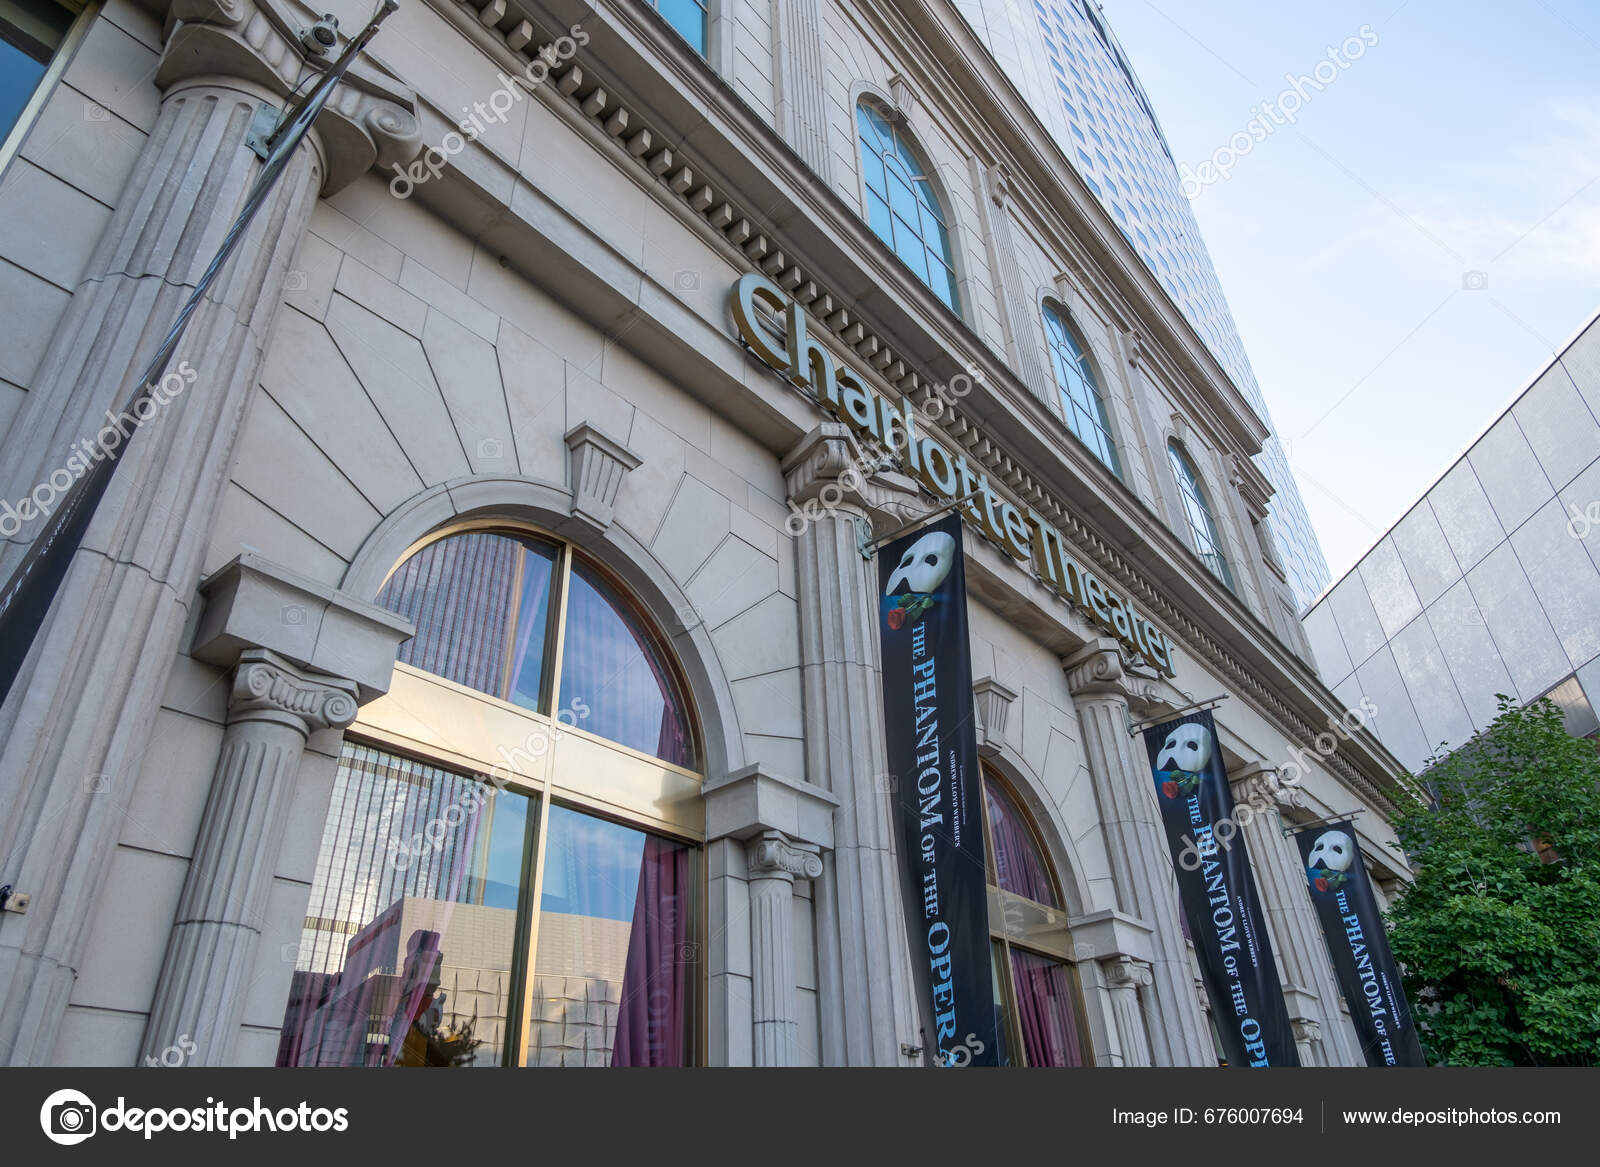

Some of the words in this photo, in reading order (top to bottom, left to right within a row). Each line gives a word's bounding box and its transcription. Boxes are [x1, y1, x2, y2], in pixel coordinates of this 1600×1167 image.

[912, 621, 926, 660] THE
[913, 656, 943, 833] PHANTOM
[949, 750, 957, 780] ANDREW
[1187, 795, 1202, 825] THE
[920, 833, 936, 864] OF
[923, 868, 939, 919] THE
[1193, 824, 1241, 955] PHANTOM
[1335, 889, 1350, 914] THE
[1223, 955, 1240, 978] OF
[1342, 913, 1388, 1018] PHANTOM
[1230, 980, 1248, 1017] THE
[1374, 1018, 1388, 1036] OF
[1380, 1039, 1396, 1067] THE
